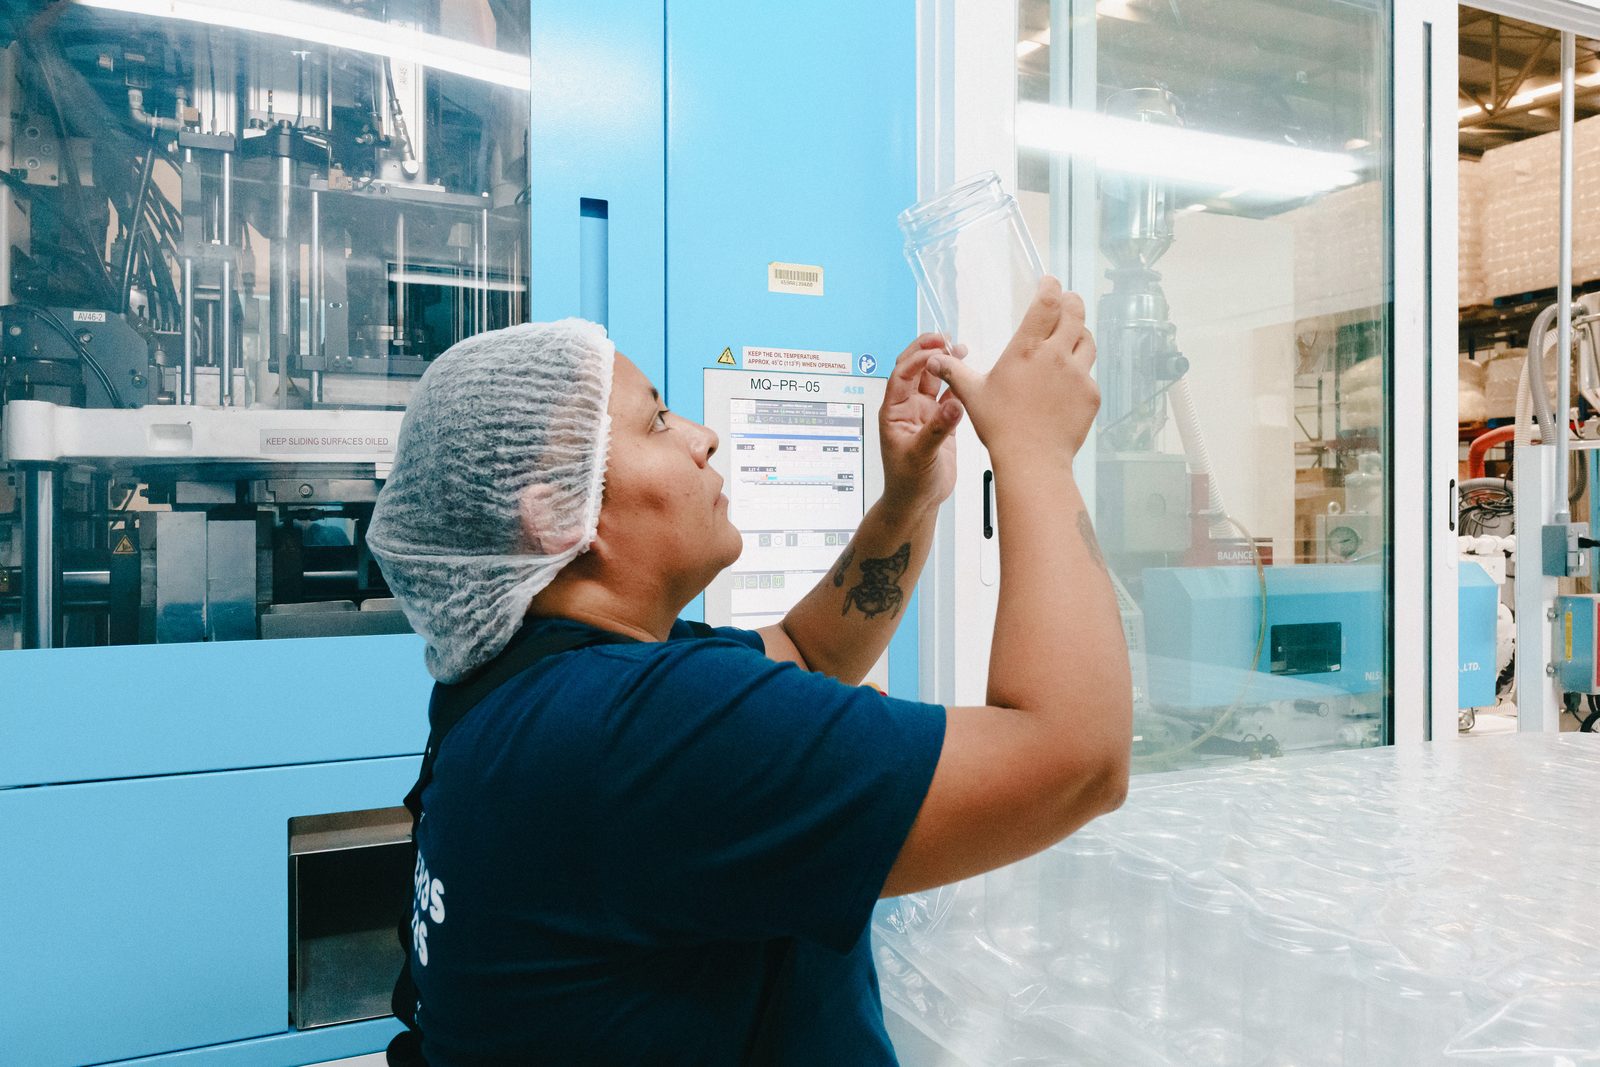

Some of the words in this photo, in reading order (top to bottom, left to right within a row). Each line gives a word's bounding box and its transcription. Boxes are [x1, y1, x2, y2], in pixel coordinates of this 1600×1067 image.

[77, 312, 103, 321] AV46-2
[783, 352, 820, 360] TEMPERATURE
[750, 378, 821, 393] MQ-PR-05
[266, 437, 287, 446] KEEP
[288, 437, 320, 446] SLIDING
[321, 437, 364, 446] SURFACES
[365, 437, 389, 446] OILED
[1217, 550, 1254, 561] BALANCE
